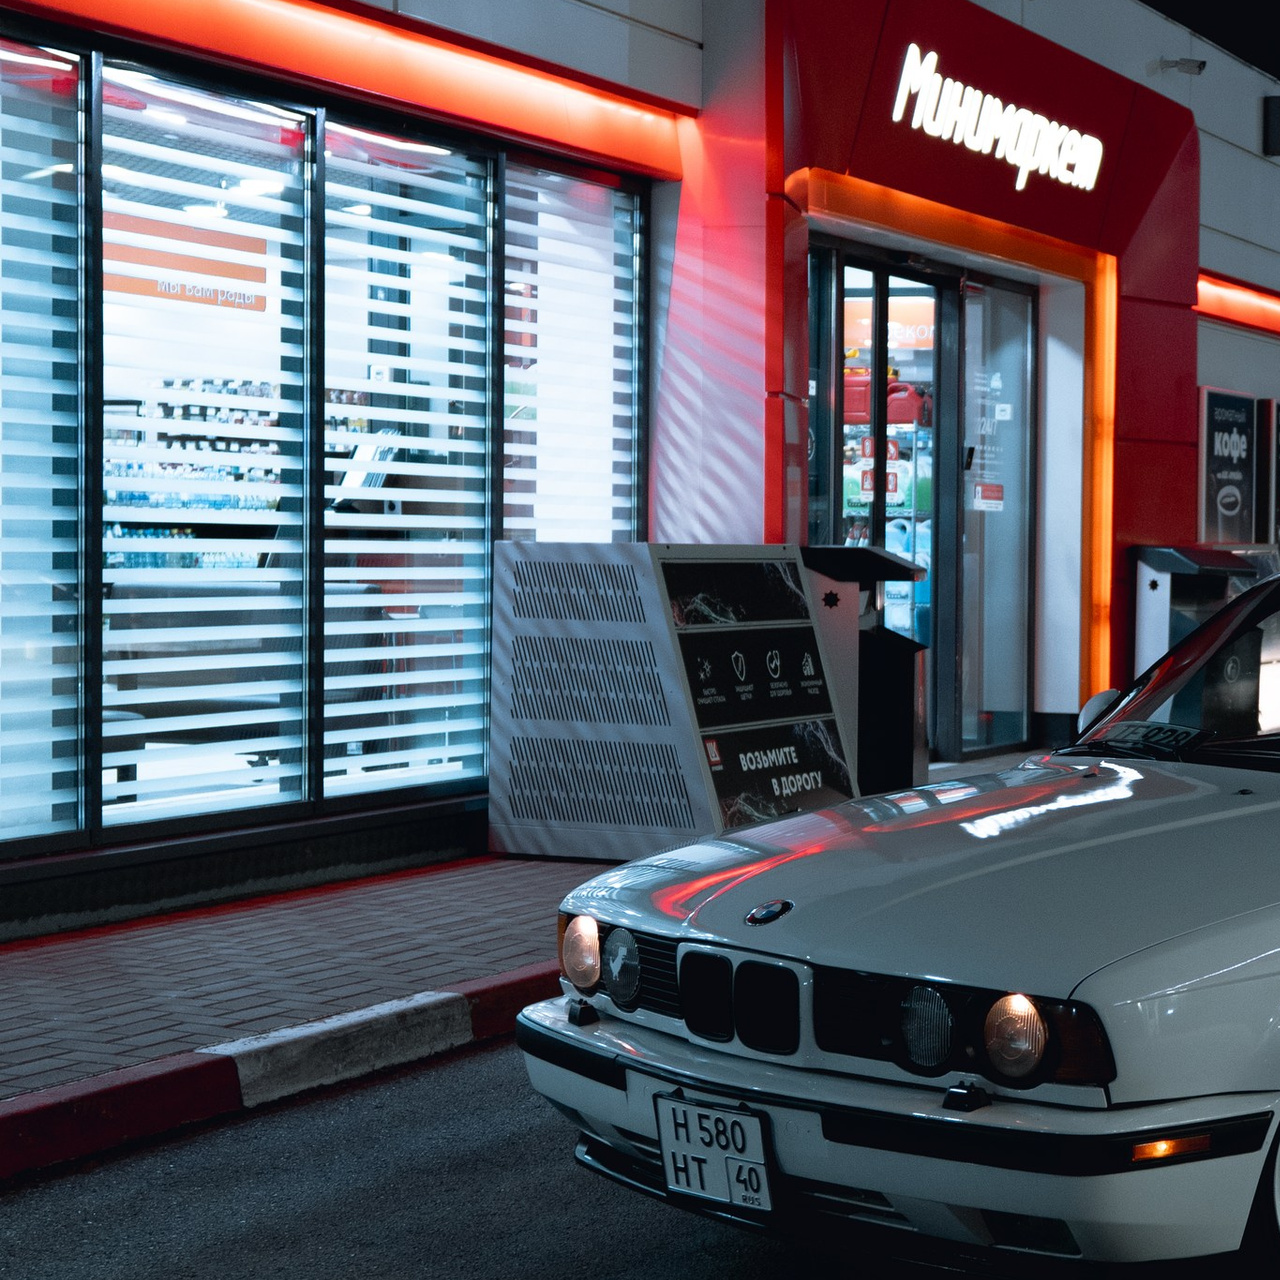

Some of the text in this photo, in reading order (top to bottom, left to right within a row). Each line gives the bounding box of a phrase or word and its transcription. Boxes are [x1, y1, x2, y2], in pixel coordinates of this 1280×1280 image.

[892, 42, 1103, 191] Минимаркет
[1213, 426, 1248, 464] кофе
[739, 746, 799, 772] ВОЗЬМИТЕ
[771, 770, 823, 798] В ДОРОГУ
[697, 1112, 746, 1154] 580
[735, 1164, 761, 1194] 40
[741, 1194, 761, 1207] RUS
